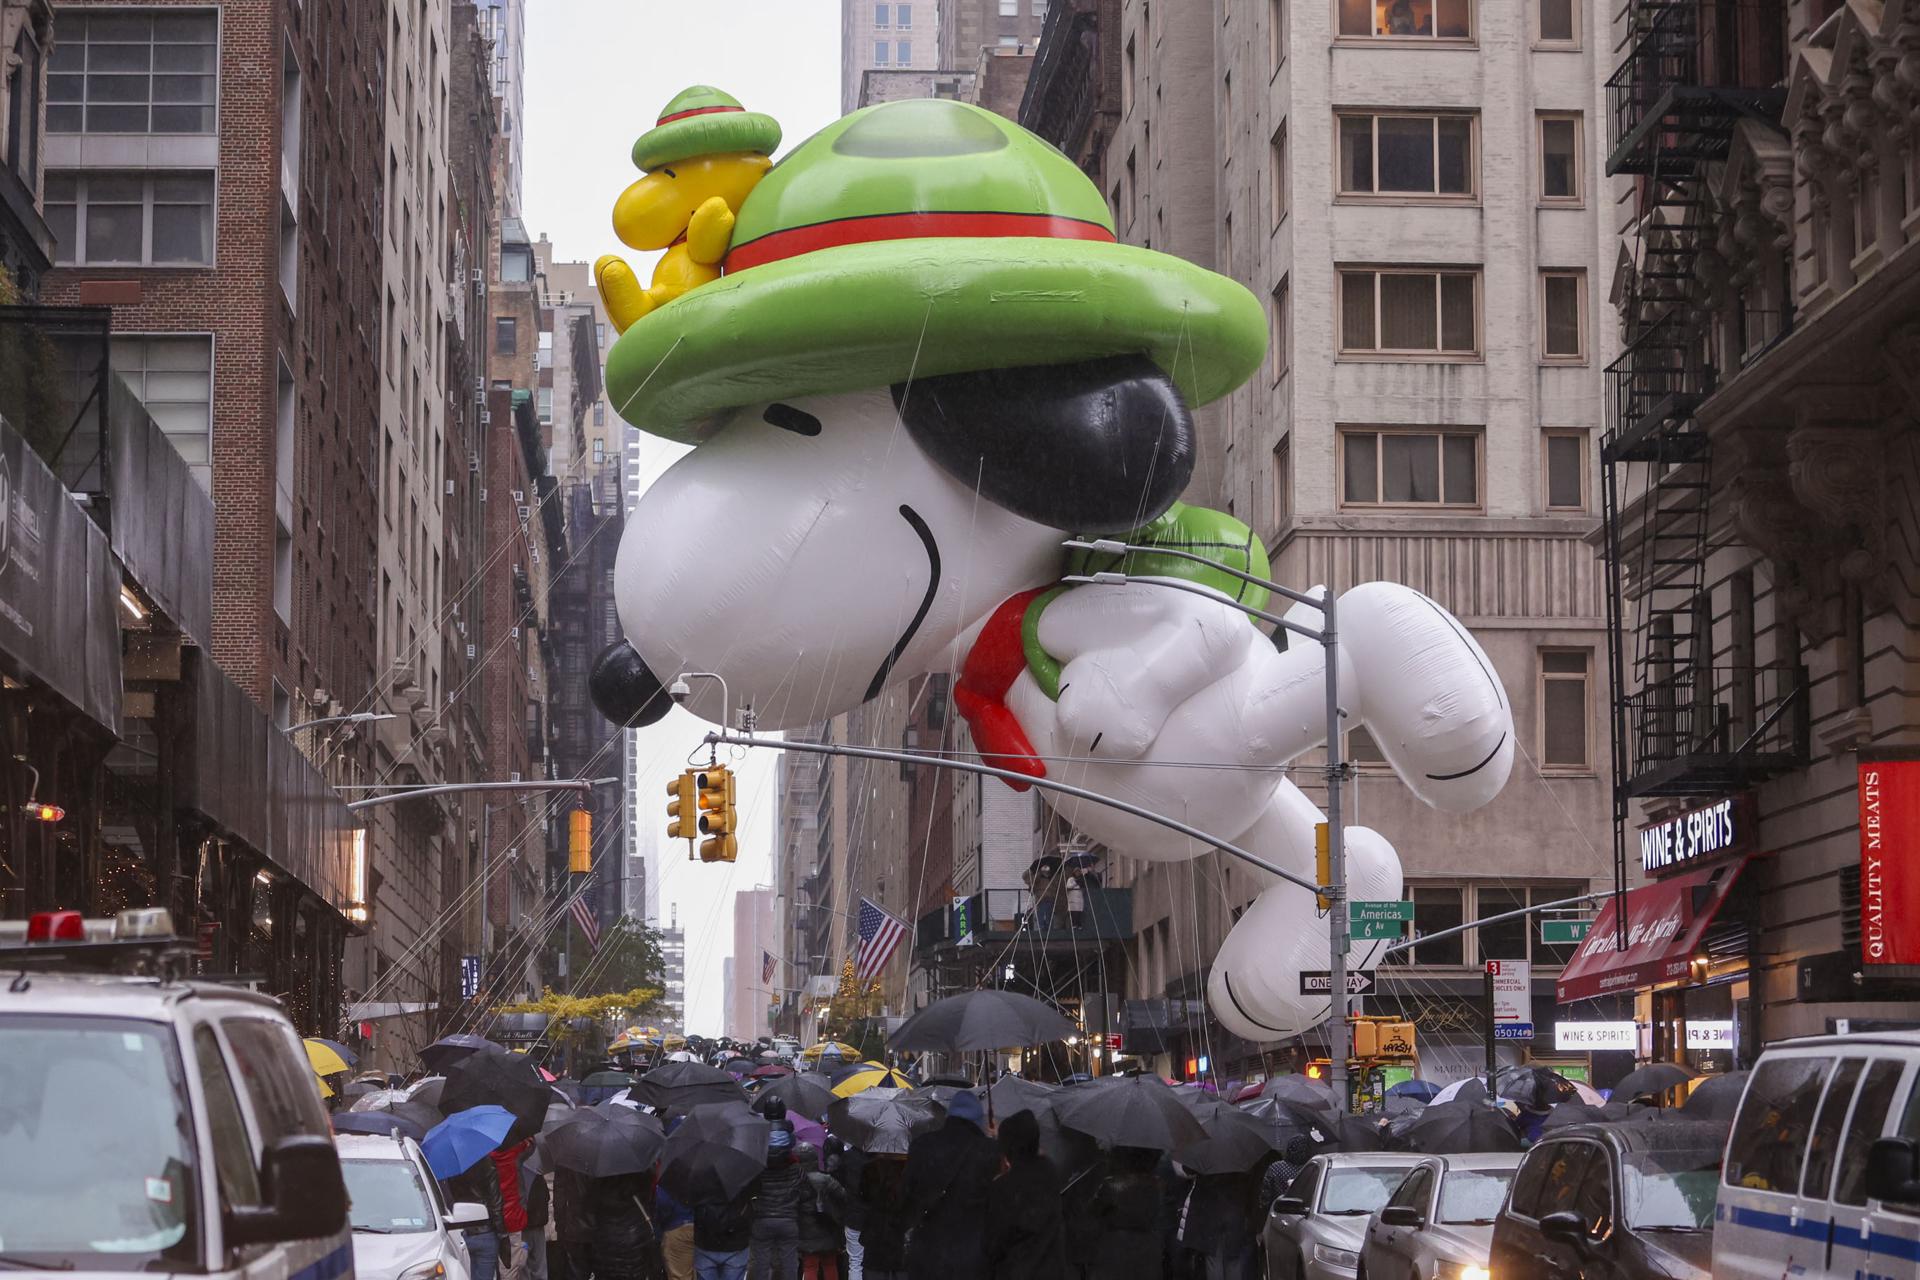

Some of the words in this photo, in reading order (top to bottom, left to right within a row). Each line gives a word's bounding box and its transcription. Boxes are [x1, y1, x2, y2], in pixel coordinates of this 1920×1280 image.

[1866, 771, 1880, 848] MEATS
[1641, 822, 1672, 871] WINE
[1675, 817, 1684, 861] &
[1686, 799, 1732, 857] SPIRITS
[1360, 910, 1402, 919] Americas
[1868, 858, 1883, 957] QUALITY
[959, 905, 967, 937] PARK
[1364, 923, 1371, 937] 6
[1375, 921, 1385, 930] Av
[1570, 925, 1580, 938] W
[1490, 962, 1498, 975] 3
[1310, 978, 1331, 988] ONE
[1562, 1031, 1585, 1041] WINE
[1587, 1031, 1594, 1041] &
[1596, 1031, 1631, 1041] SPIRITS
